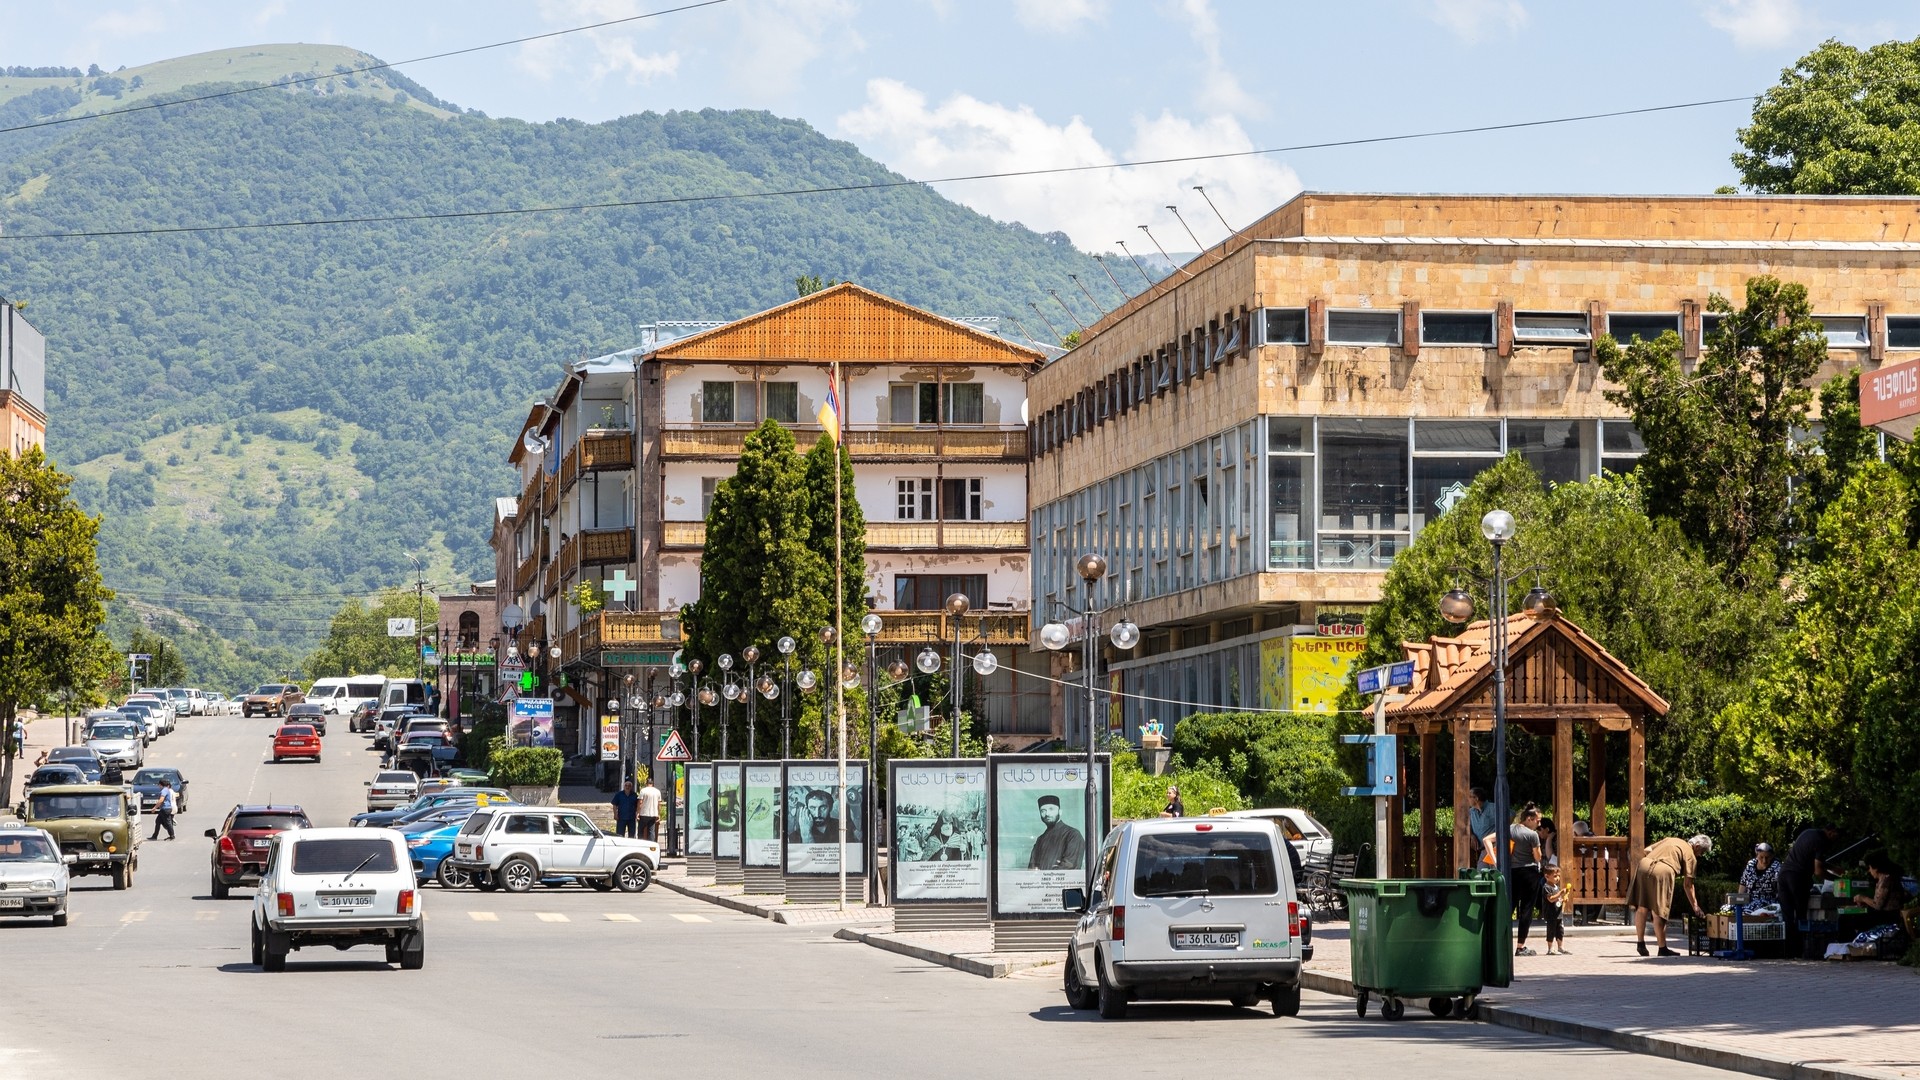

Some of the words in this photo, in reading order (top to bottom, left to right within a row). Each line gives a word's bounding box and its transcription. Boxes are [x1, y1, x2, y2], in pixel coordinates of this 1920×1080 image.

[1873, 367, 1917, 400] ՀԱՅՓՈՍՏ
[356, 897, 369, 905] 105
[1189, 934, 1200, 944] 36
[1203, 934, 1217, 944] RL
[1219, 933, 1237, 943] 605
